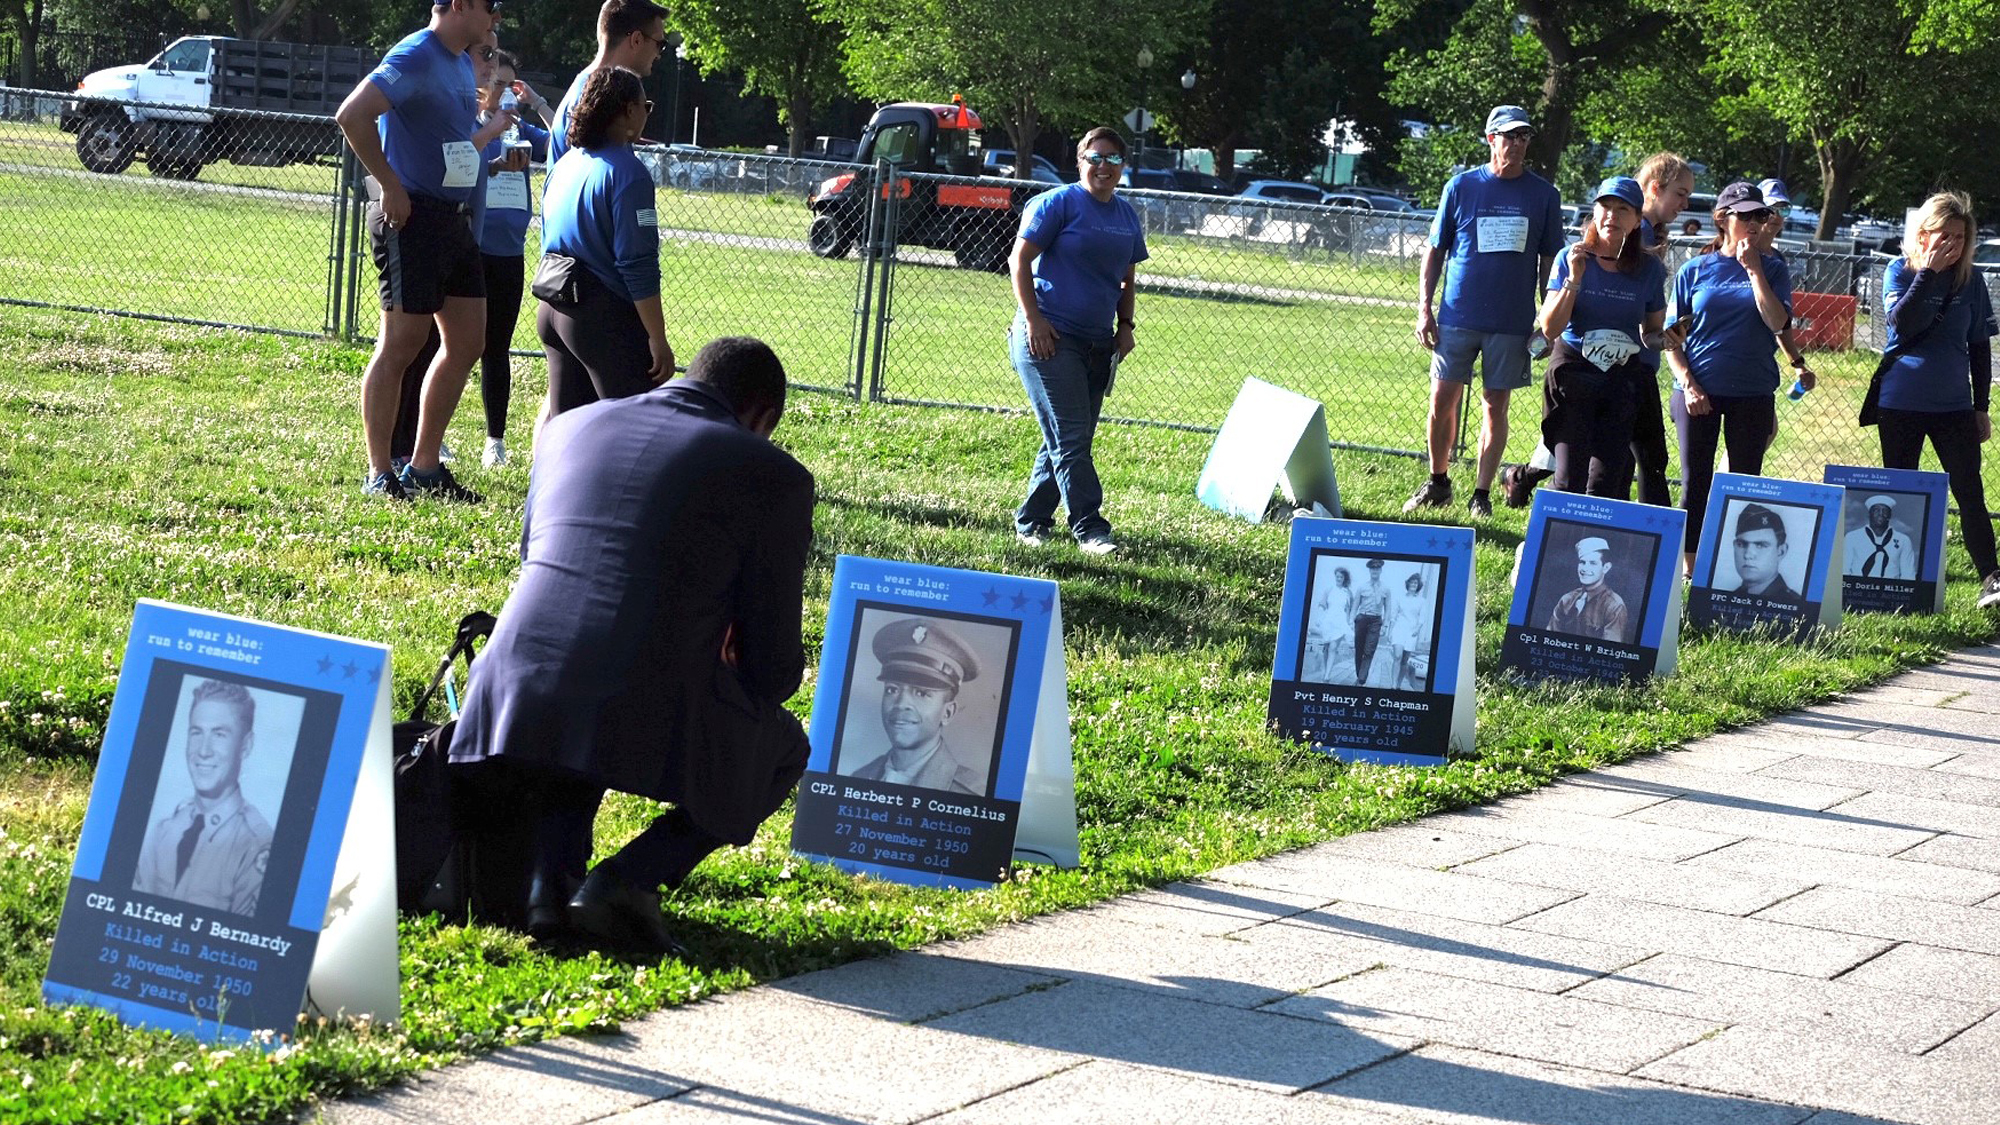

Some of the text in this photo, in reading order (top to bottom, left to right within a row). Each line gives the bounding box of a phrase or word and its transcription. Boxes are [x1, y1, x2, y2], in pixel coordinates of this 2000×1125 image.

[1748, 488, 1782, 496] remember
[1567, 502, 1613, 514] wear blue:
[1574, 510, 1613, 520] remember
[1326, 536, 1338, 544] to
[1341, 538, 1388, 547] remember
[1333, 529, 1388, 539] wear blue:
[850, 581, 949, 601] run to remember
[884, 575, 950, 590] wear blue:
[1855, 582, 1880, 591] Doris
[1884, 584, 1915, 594] Miller
[1711, 593, 1727, 602] PFC
[1731, 596, 1752, 606] Jack
[1767, 601, 1798, 611] Powers
[1712, 604, 1743, 615] Killed
[188, 627, 263, 651] wear blue:
[1520, 633, 1640, 661] Cpl Robert W Brigham
[148, 635, 262, 665] run to remember
[1530, 647, 1625, 670] Killed in Action
[1530, 657, 1543, 666] 23
[1548, 660, 1590, 674] October
[1294, 690, 1429, 712] Pvt Henry S Chapman
[1302, 705, 1416, 723] Killed in Action
[1302, 718, 1415, 736] 19 February 1945
[1314, 730, 1398, 747] 20 years old
[810, 782, 1006, 822] CPL Herbert P Cornelius
[838, 805, 972, 836] Killed in Action
[835, 823, 969, 854] 27 November 1950
[848, 841, 950, 869] 20 years old
[86, 892, 292, 957] CPL Alfred J Bernardy
[105, 922, 258, 972] Killed in Action
[99, 947, 252, 996] 29 November 1950
[111, 972, 132, 990] 22
[138, 982, 188, 1005] years
